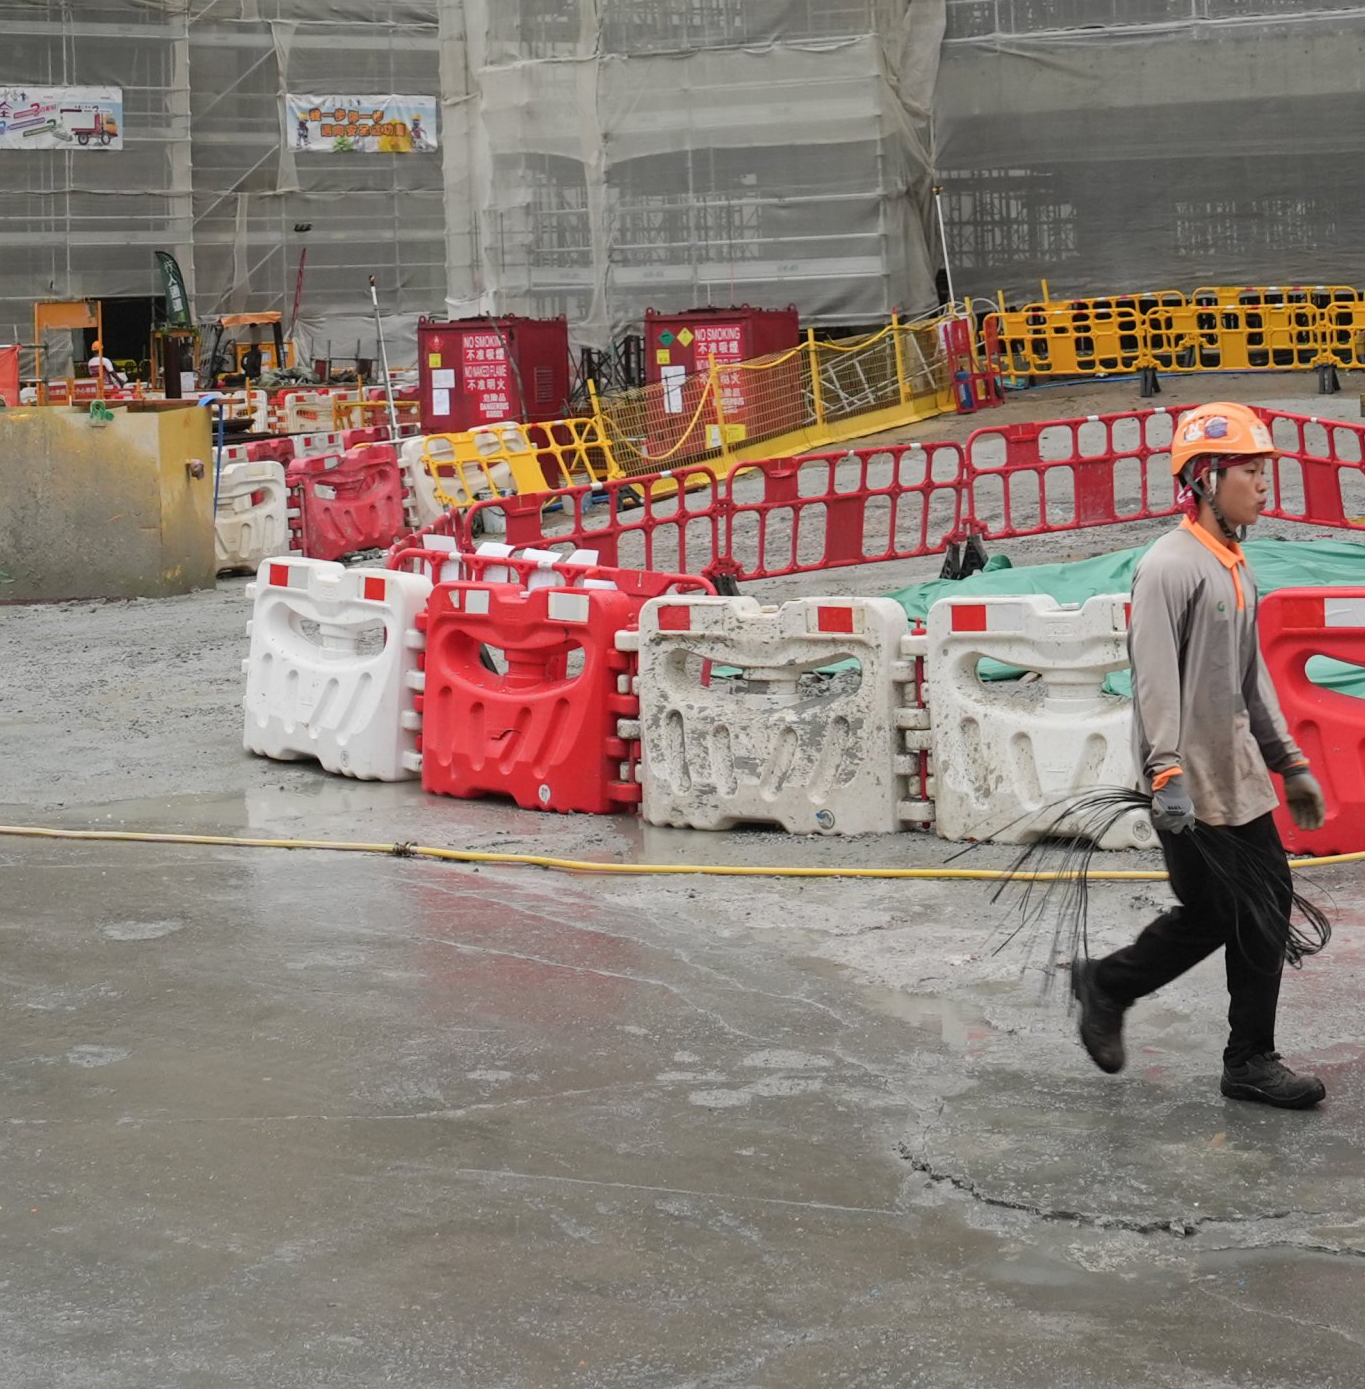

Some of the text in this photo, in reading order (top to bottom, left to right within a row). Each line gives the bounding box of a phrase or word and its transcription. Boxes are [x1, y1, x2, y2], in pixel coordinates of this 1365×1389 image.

[695, 327, 740, 340] NO SMOKING
[463, 335, 507, 348] NO SMOKING
[698, 341, 739, 354] 不准吸煙
[466, 348, 505, 360] 不准吸煙
[464, 365, 473, 378] NO
[466, 378, 505, 390] 不准明火
[483, 393, 506, 402] 危險品
